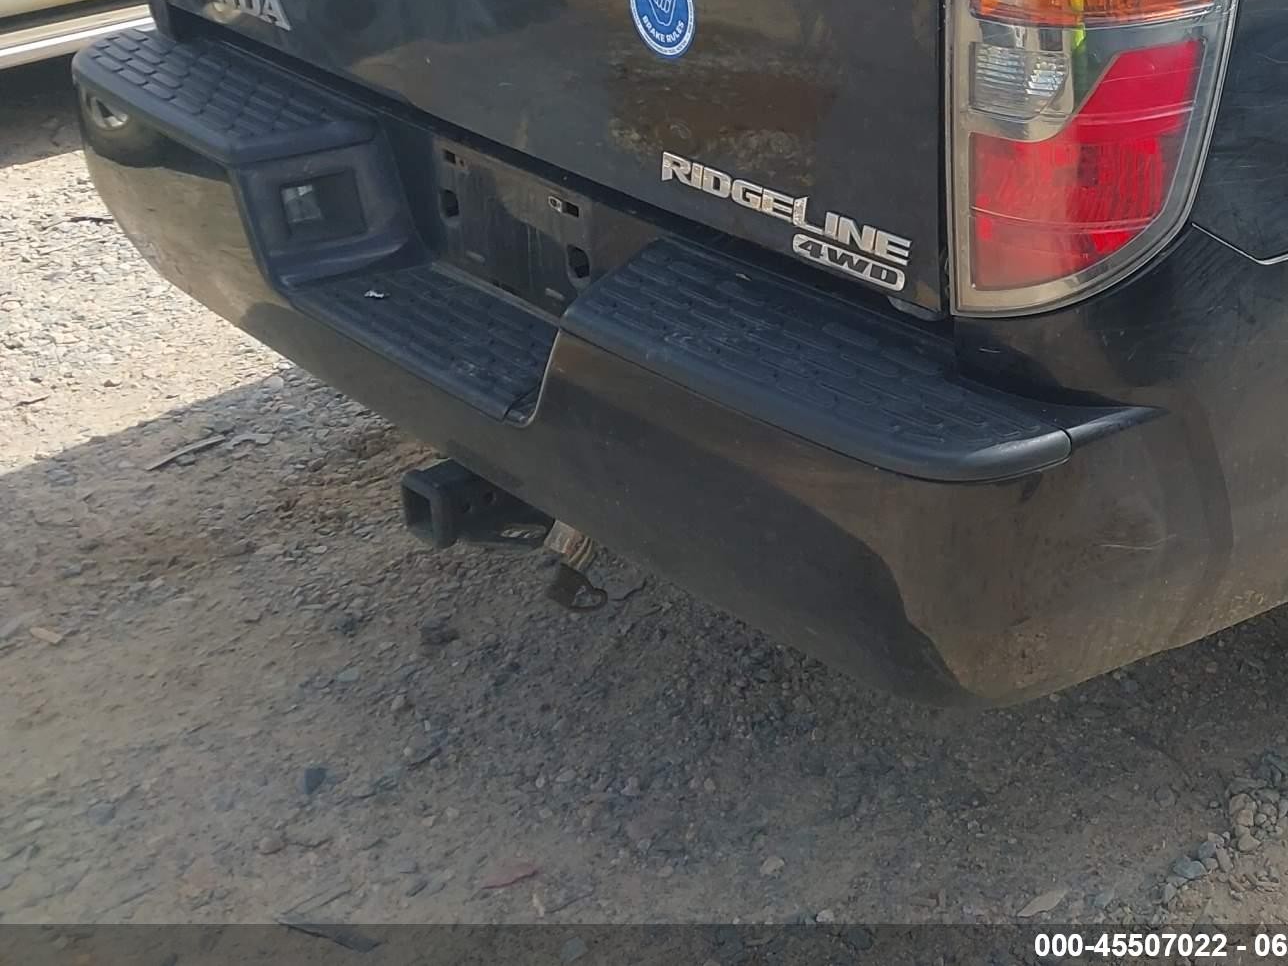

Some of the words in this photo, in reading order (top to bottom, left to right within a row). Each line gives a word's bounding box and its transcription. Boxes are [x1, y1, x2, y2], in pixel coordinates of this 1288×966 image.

[642, 15, 666, 43] BRAKE
[666, 21, 685, 43] RULES
[660, 150, 913, 268] RIDGELINE
[796, 240, 899, 286] 4WD
